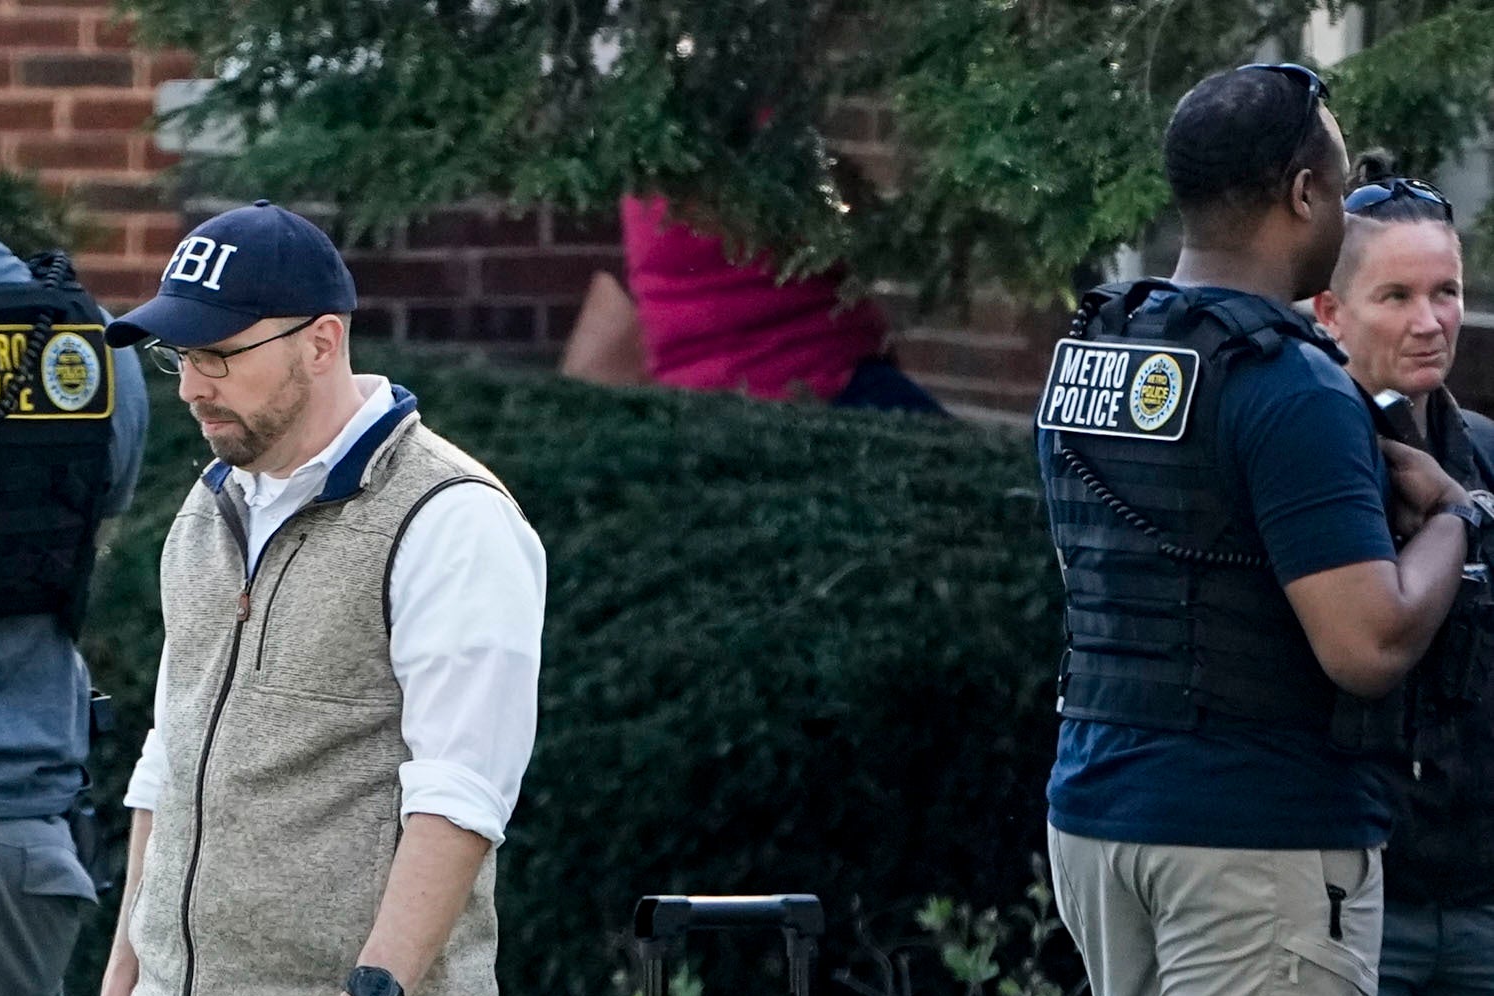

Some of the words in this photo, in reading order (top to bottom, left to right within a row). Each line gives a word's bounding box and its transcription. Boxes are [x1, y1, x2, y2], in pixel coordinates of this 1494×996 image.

[161, 236, 238, 290] FBI
[1058, 347, 1130, 389] METRO
[1047, 385, 1124, 427] POLICE
